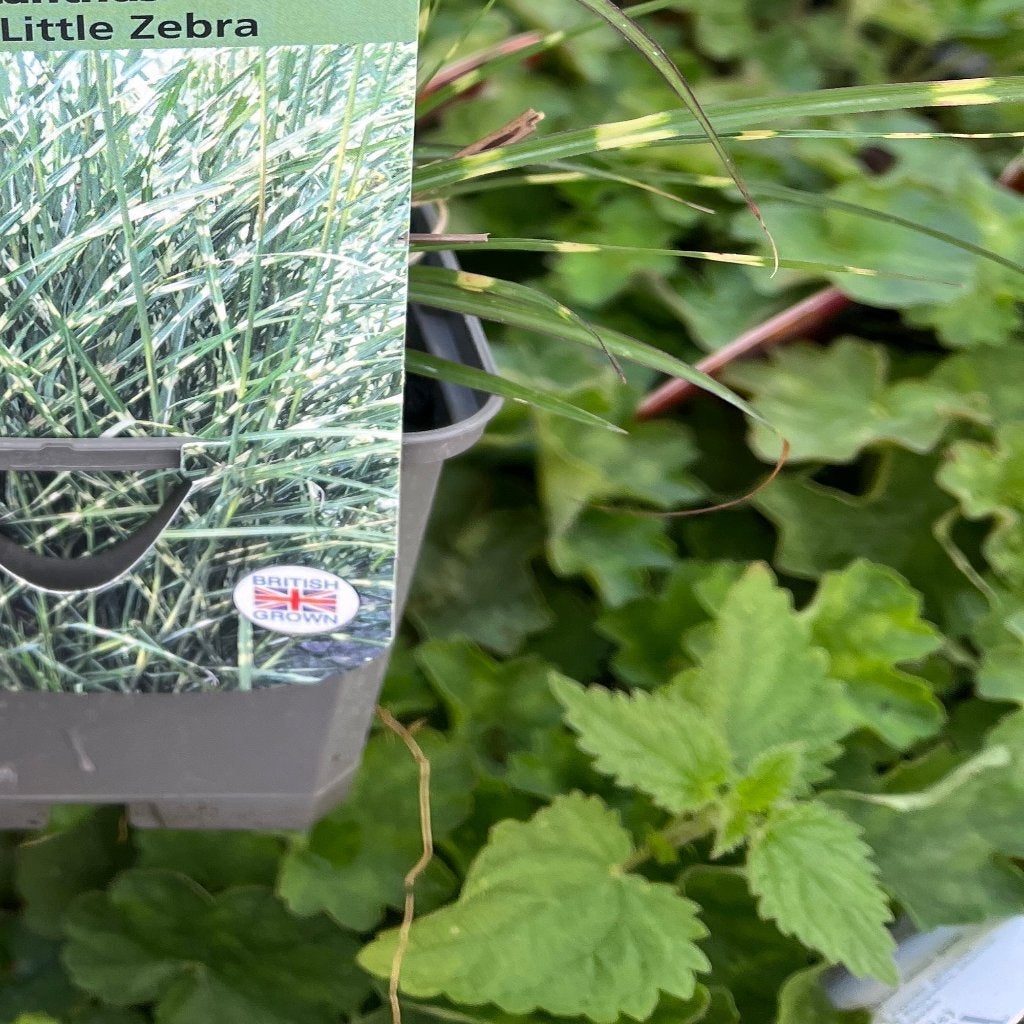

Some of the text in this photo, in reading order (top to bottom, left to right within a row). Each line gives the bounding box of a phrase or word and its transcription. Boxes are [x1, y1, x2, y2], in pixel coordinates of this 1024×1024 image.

[0, 14, 114, 42] Little
[130, 12, 259, 40] Zebra
[253, 576, 339, 590] BRITISH
[253, 610, 339, 624] GROWN
